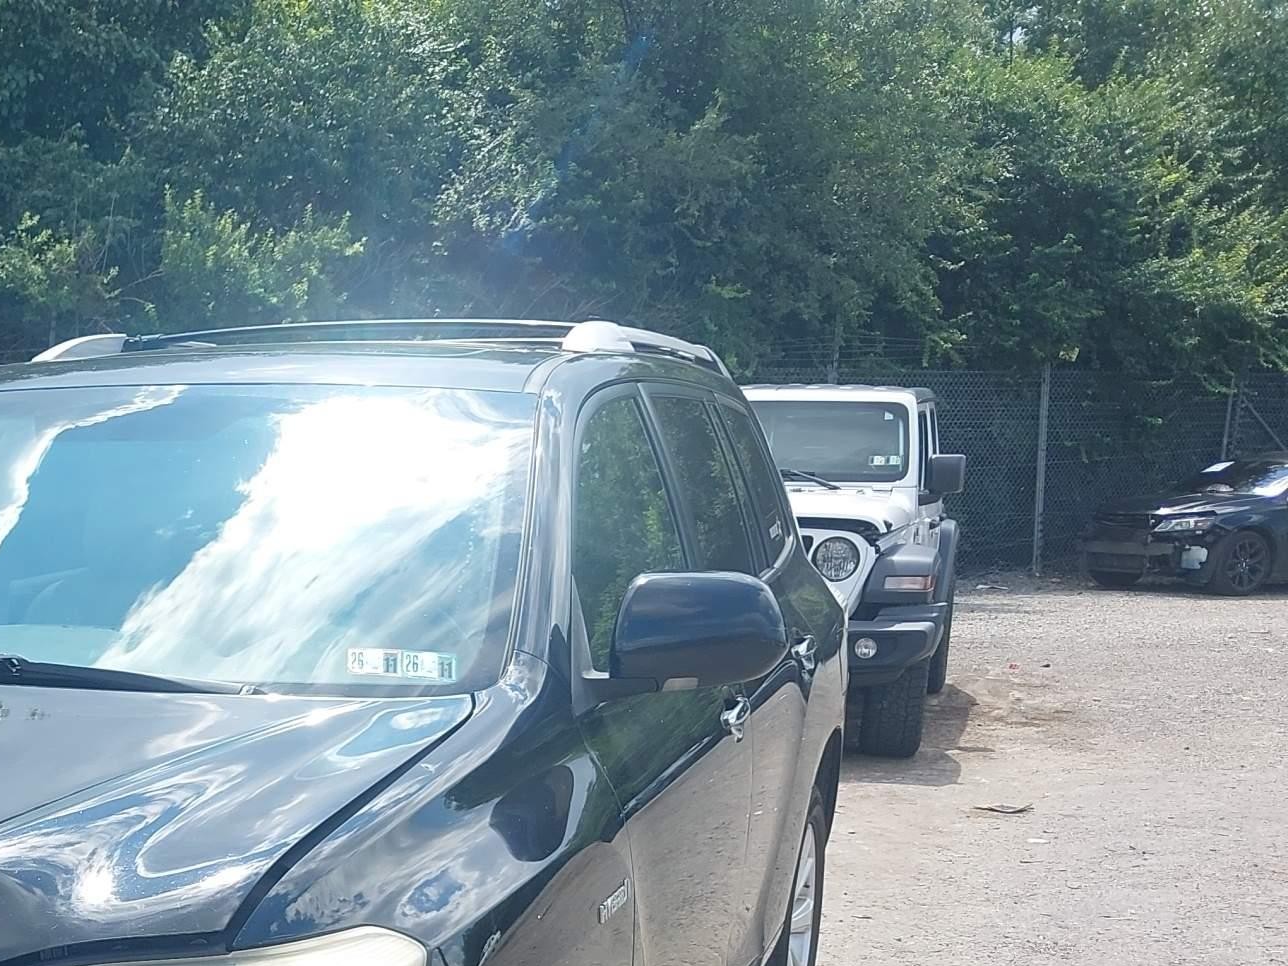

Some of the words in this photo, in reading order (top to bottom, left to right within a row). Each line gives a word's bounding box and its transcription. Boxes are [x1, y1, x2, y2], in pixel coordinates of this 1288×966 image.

[351, 651, 365, 669] 26
[383, 655, 398, 673] 11
[405, 654, 419, 672] 26
[439, 660, 453, 678] 11
